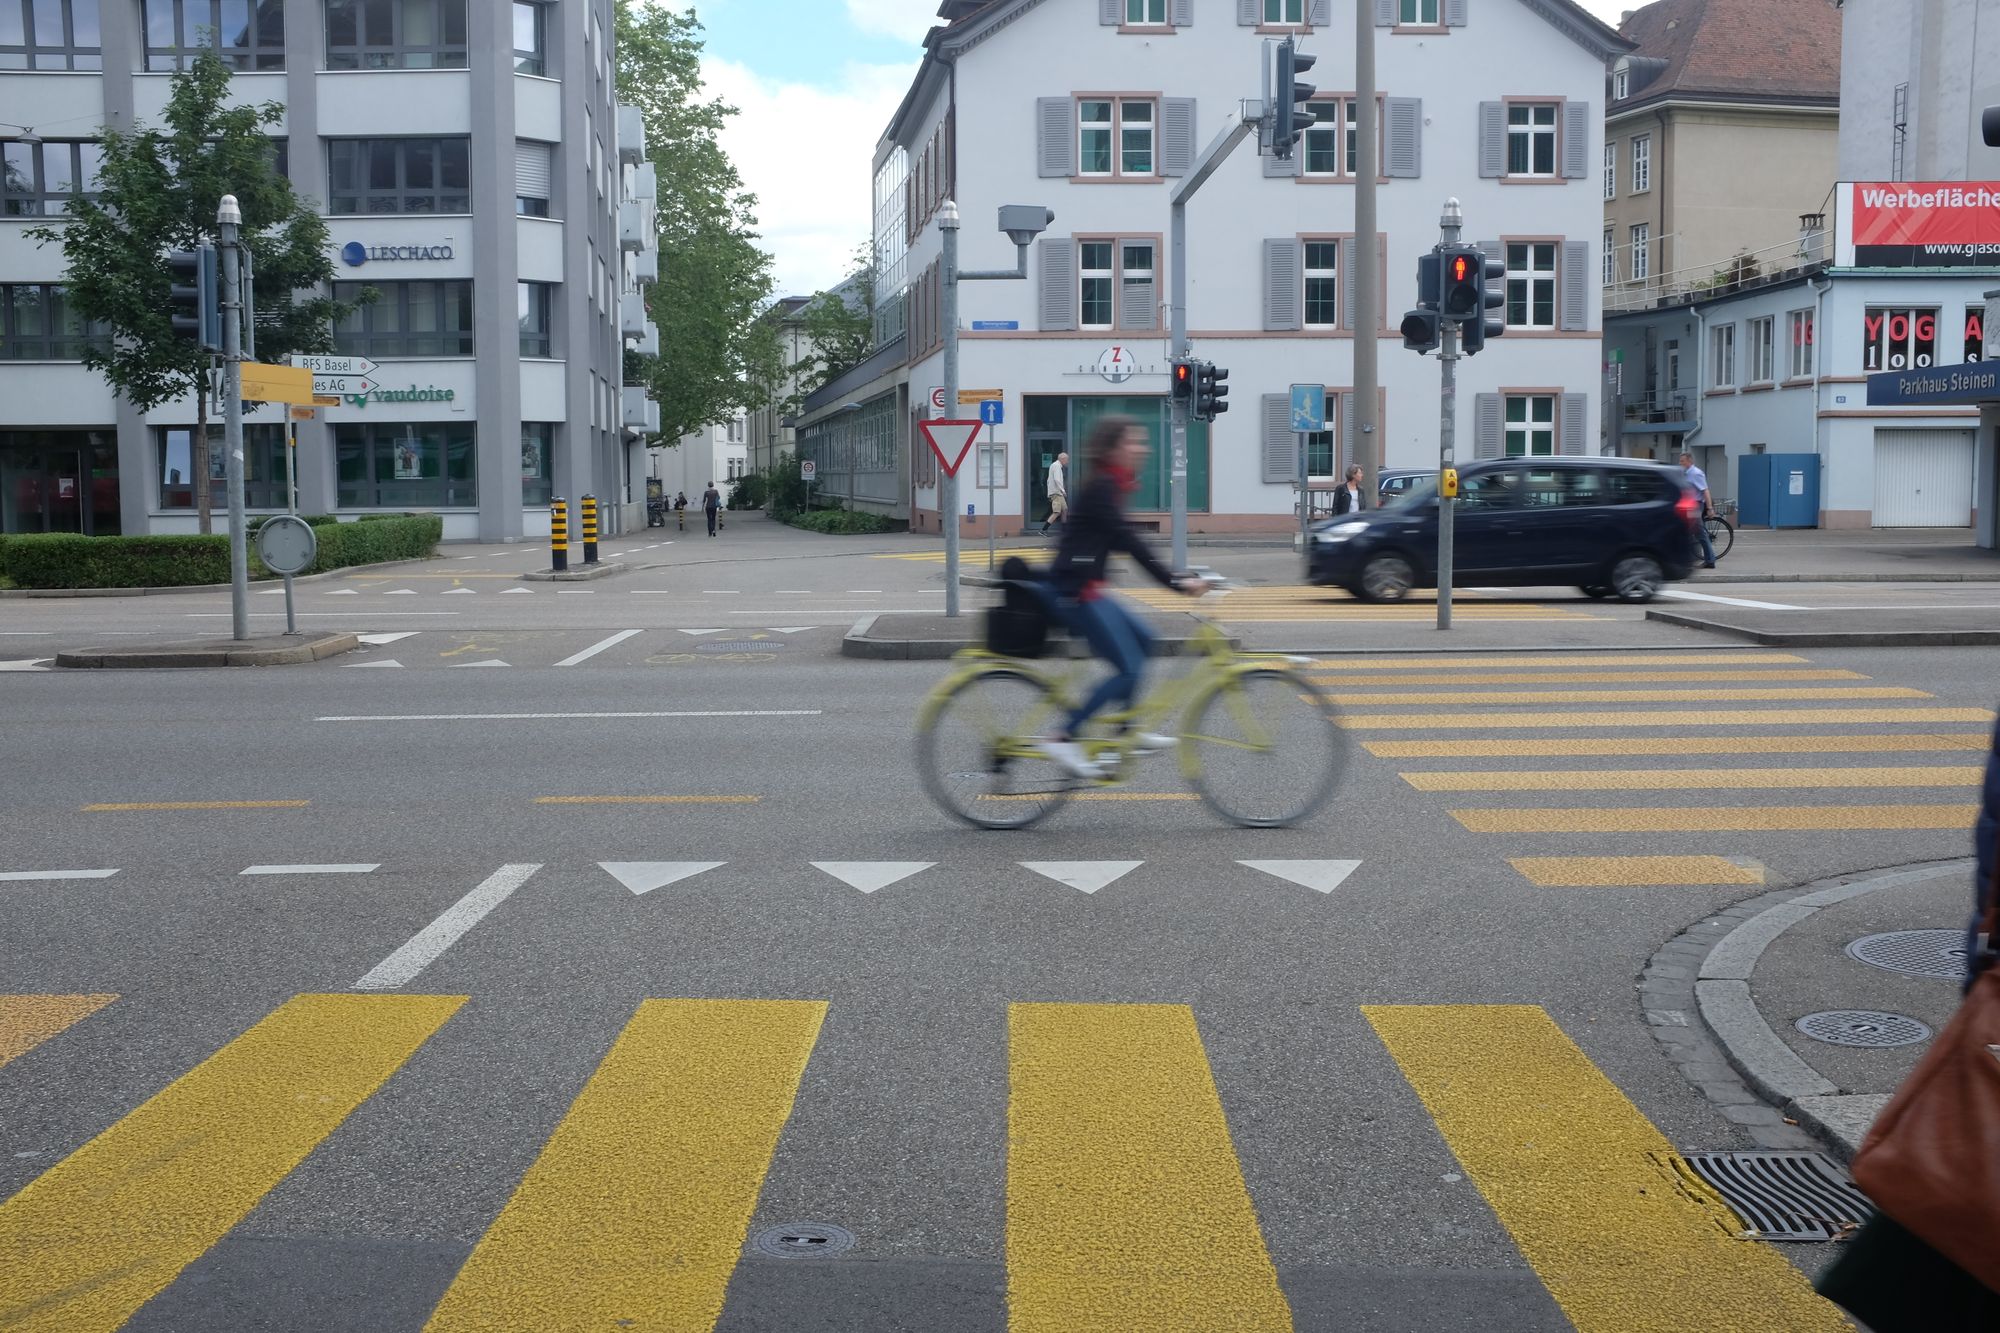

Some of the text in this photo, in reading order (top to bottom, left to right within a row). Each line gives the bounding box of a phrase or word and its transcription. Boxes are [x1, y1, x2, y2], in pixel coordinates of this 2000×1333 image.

[1862, 189, 2000, 208] Werbefläche
[371, 245, 452, 261] LESCHACO
[302, 358, 352, 371] BFS Basel
[329, 379, 345, 391] AG
[1900, 371, 1995, 395] Parkhaus Steinen
[373, 384, 455, 402] vaudoise
